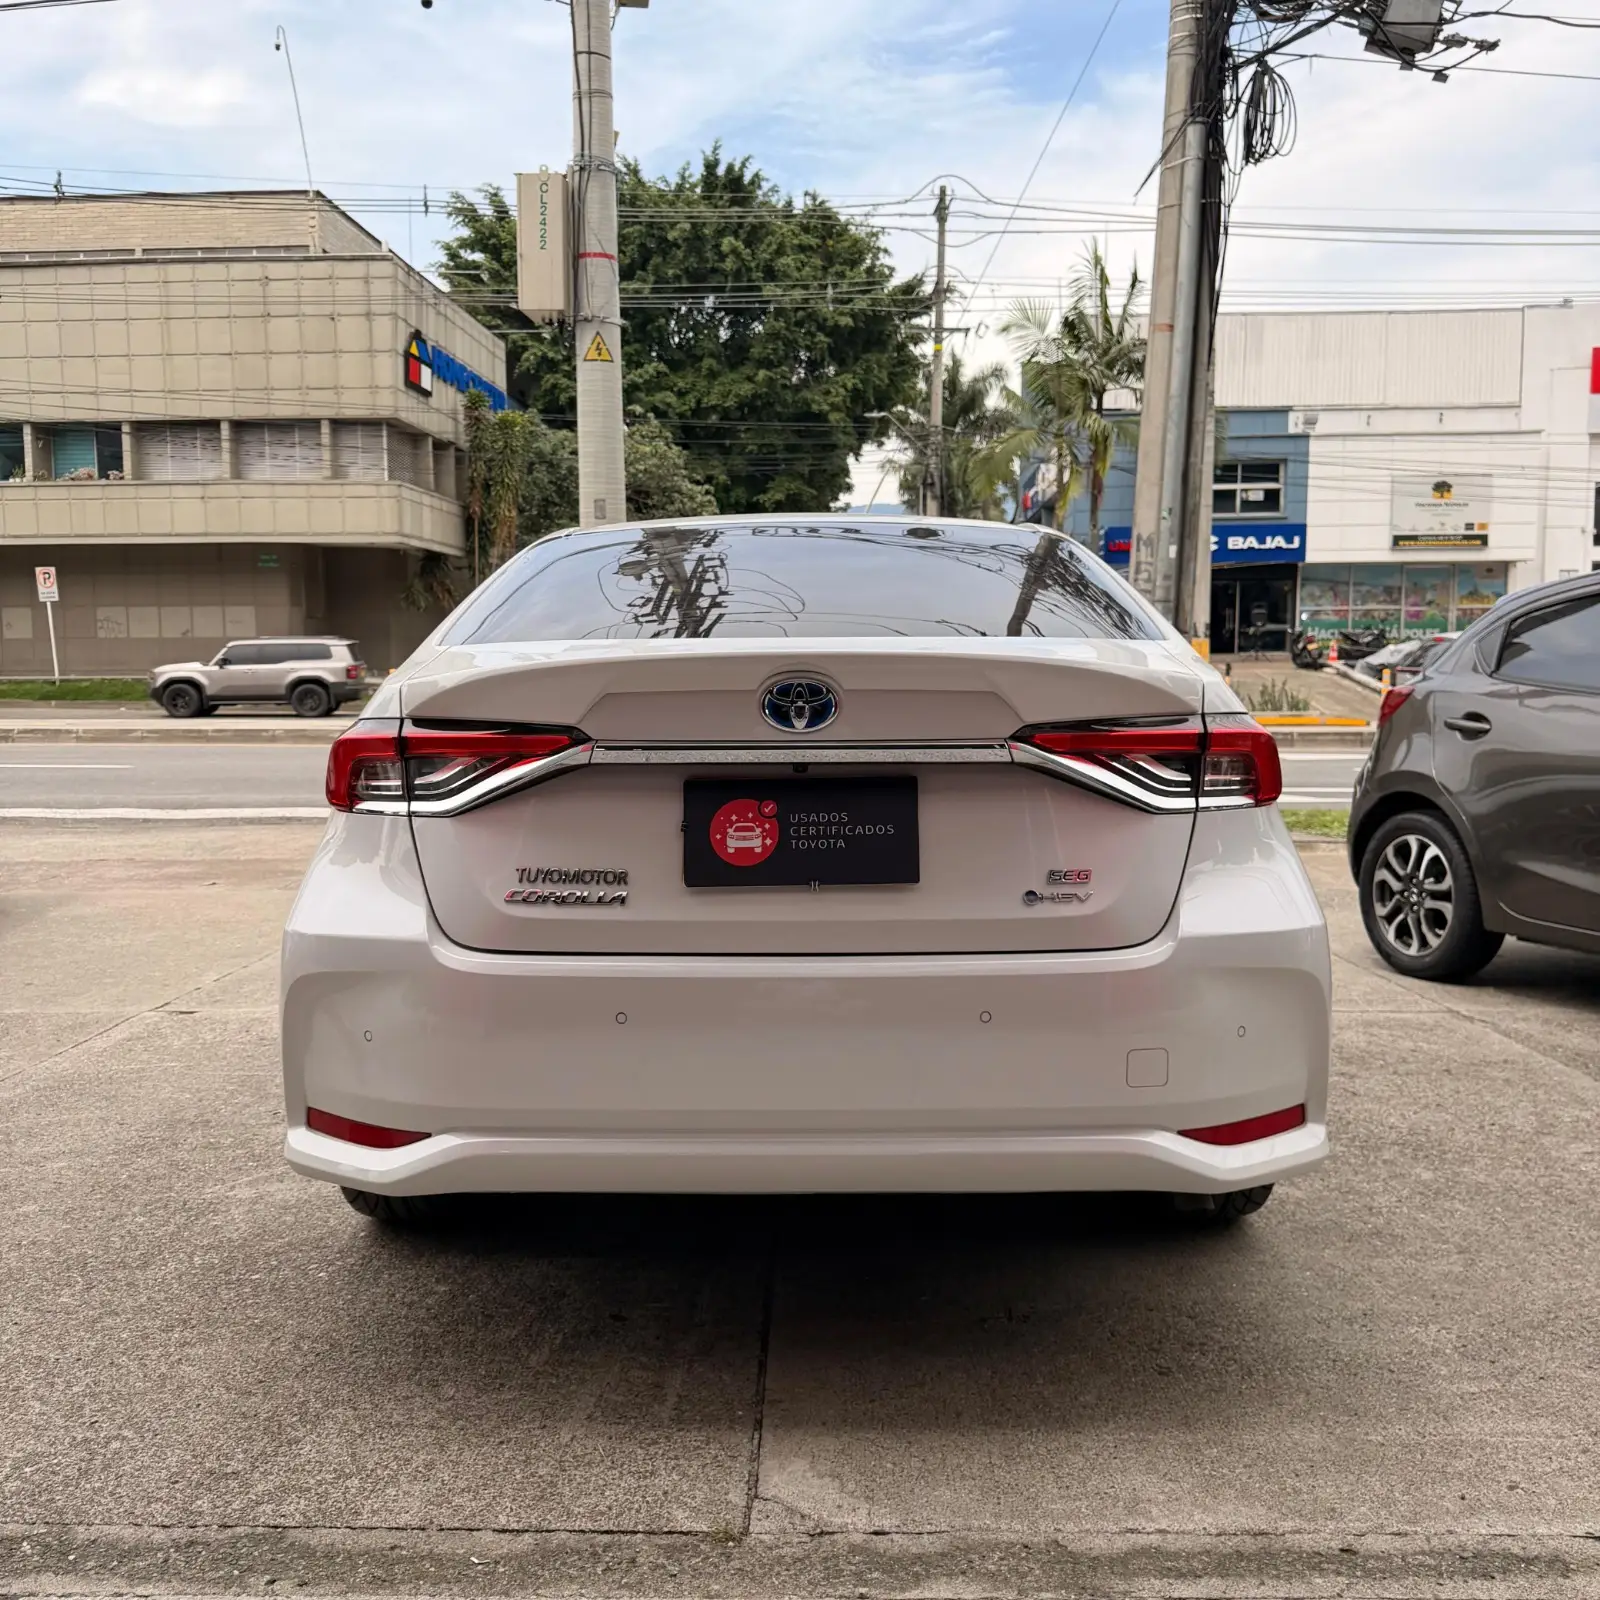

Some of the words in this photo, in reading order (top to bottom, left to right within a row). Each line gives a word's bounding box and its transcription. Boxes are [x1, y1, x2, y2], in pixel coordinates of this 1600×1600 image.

[1227, 535, 1301, 550] BAJAJ
[790, 812, 849, 823] USADOS
[790, 824, 895, 836] CERTIFICADOS
[790, 839, 846, 849] TOYOTA
[516, 867, 629, 886] TUYOMOTOR
[1048, 868, 1092, 885] SEG
[504, 888, 628, 905] COROLLA
